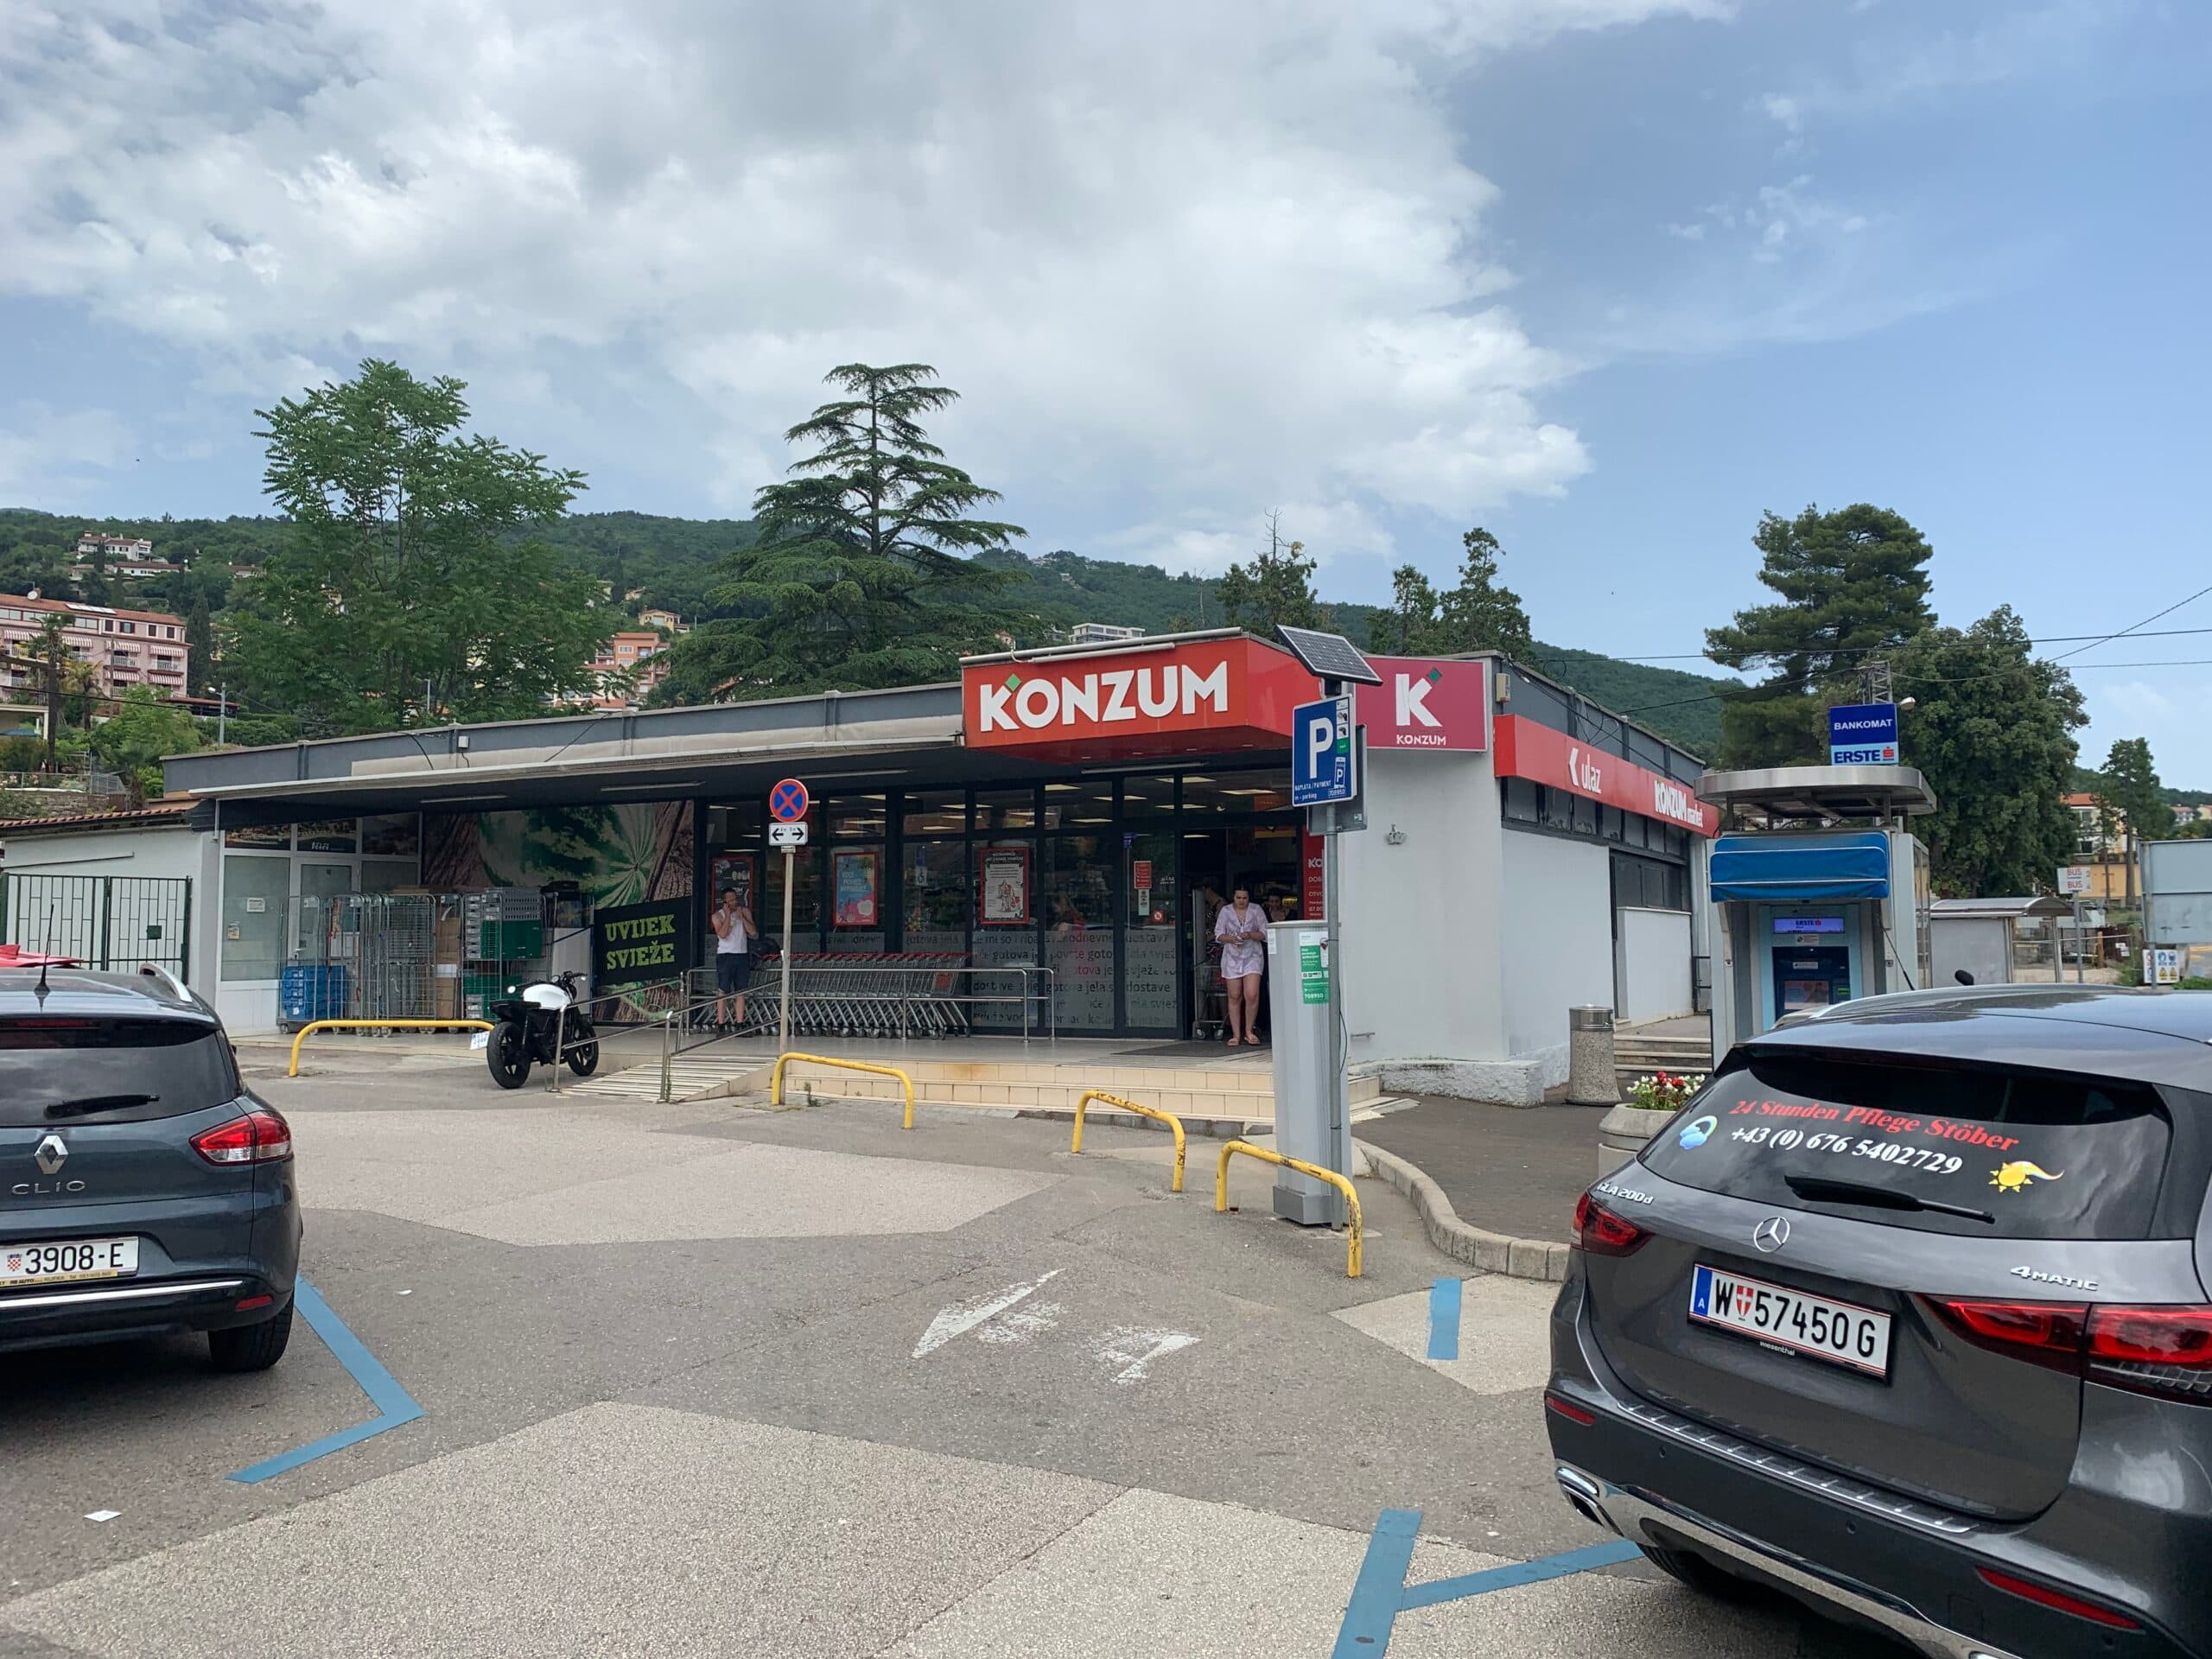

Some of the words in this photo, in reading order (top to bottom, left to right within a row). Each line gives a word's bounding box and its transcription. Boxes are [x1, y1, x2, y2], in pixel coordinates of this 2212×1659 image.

[980, 660, 1228, 733] KONZUM
[1395, 671, 1443, 728] K
[1834, 718, 1892, 731] BANKOMAT
[1309, 717, 1333, 779] P
[1396, 734, 1446, 746] KONZUM
[1834, 749, 1881, 764] ERSTE
[1581, 753, 1602, 794] ulaz
[1294, 782, 1312, 791] NAPLATA
[1313, 779, 1332, 789] PAYMENT
[1302, 791, 1317, 802] parking
[1654, 779, 1688, 822] KONZUM
[1687, 803, 1703, 828] market
[2067, 868, 2082, 876] BUS
[2067, 880, 2083, 889] BUS
[605, 914, 676, 942] UVIJEK
[607, 940, 675, 970] SVJEŽE
[1729, 1100, 1758, 1116] 24
[1756, 1100, 1840, 1121] Stunden
[1842, 1105, 1921, 1134] Pflege
[1924, 1117, 2019, 1152] Stöber
[1732, 1126, 1771, 1145] +43
[1769, 1128, 1805, 1151] (0)
[1807, 1133, 1848, 1154] 676
[1852, 1139, 1963, 1174] 5402729
[11, 1180, 86, 1195] CLIO
[1618, 1188, 1654, 1205] 200d
[2010, 1265, 2099, 1292] 4MATIC
[1698, 1297, 1706, 1309] A
[1715, 1278, 1734, 1317] W
[1857, 1319, 1876, 1357] G
[1759, 1340, 1796, 1357] wiesenthal
